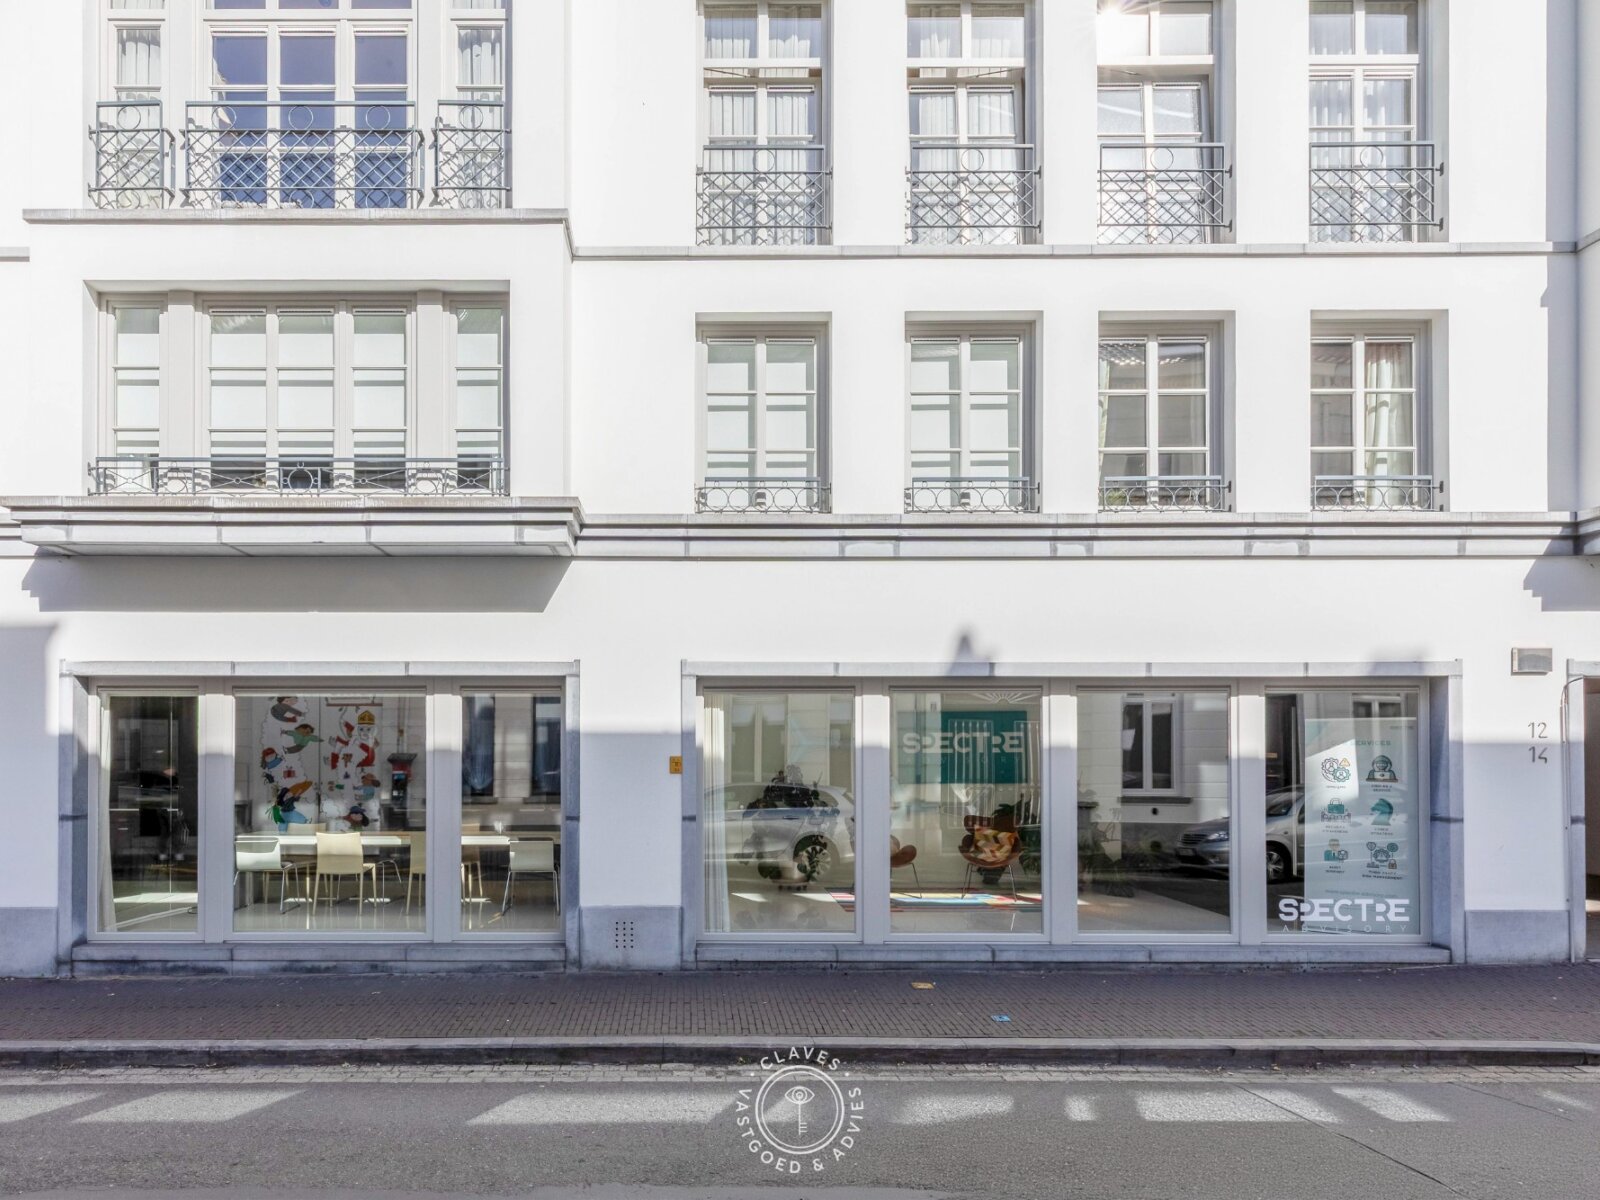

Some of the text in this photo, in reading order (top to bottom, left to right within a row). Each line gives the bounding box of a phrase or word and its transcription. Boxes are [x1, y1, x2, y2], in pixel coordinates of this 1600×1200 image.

[1528, 722, 1548, 739] 12
[902, 732, 1024, 754] SPECTRE
[1528, 746, 1548, 764] 14
[1278, 898, 1410, 922] SPECTRE
[1282, 924, 1407, 933] ADVISORY
